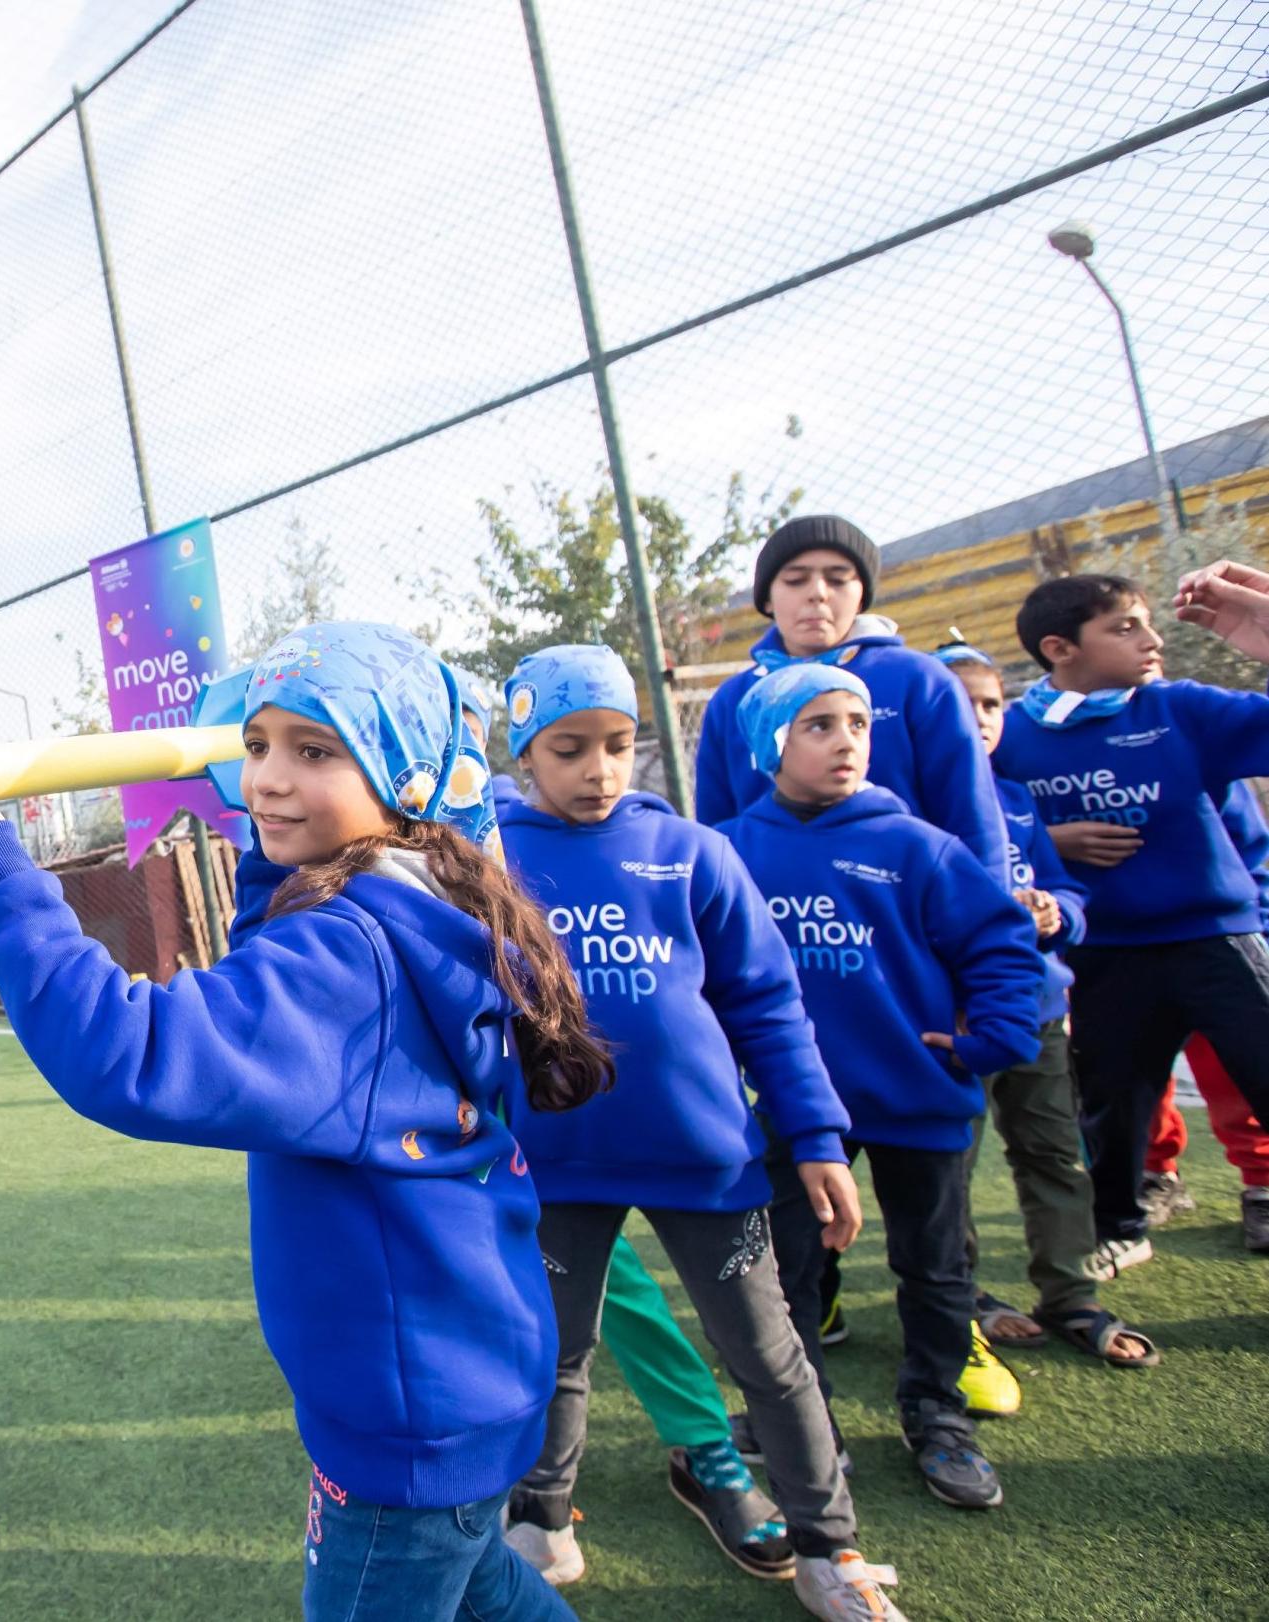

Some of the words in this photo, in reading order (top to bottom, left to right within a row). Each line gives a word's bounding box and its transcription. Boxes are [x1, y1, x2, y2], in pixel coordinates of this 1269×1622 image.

[114, 650, 189, 690] move
[131, 705, 195, 732] cam
[1026, 769, 1116, 798] move
[1081, 781, 1161, 812] now
[547, 902, 626, 935] ove
[768, 894, 836, 919] ove
[582, 934, 674, 963] now
[798, 920, 875, 947] now
[792, 946, 865, 979] mp
[575, 967, 658, 1004] mp
